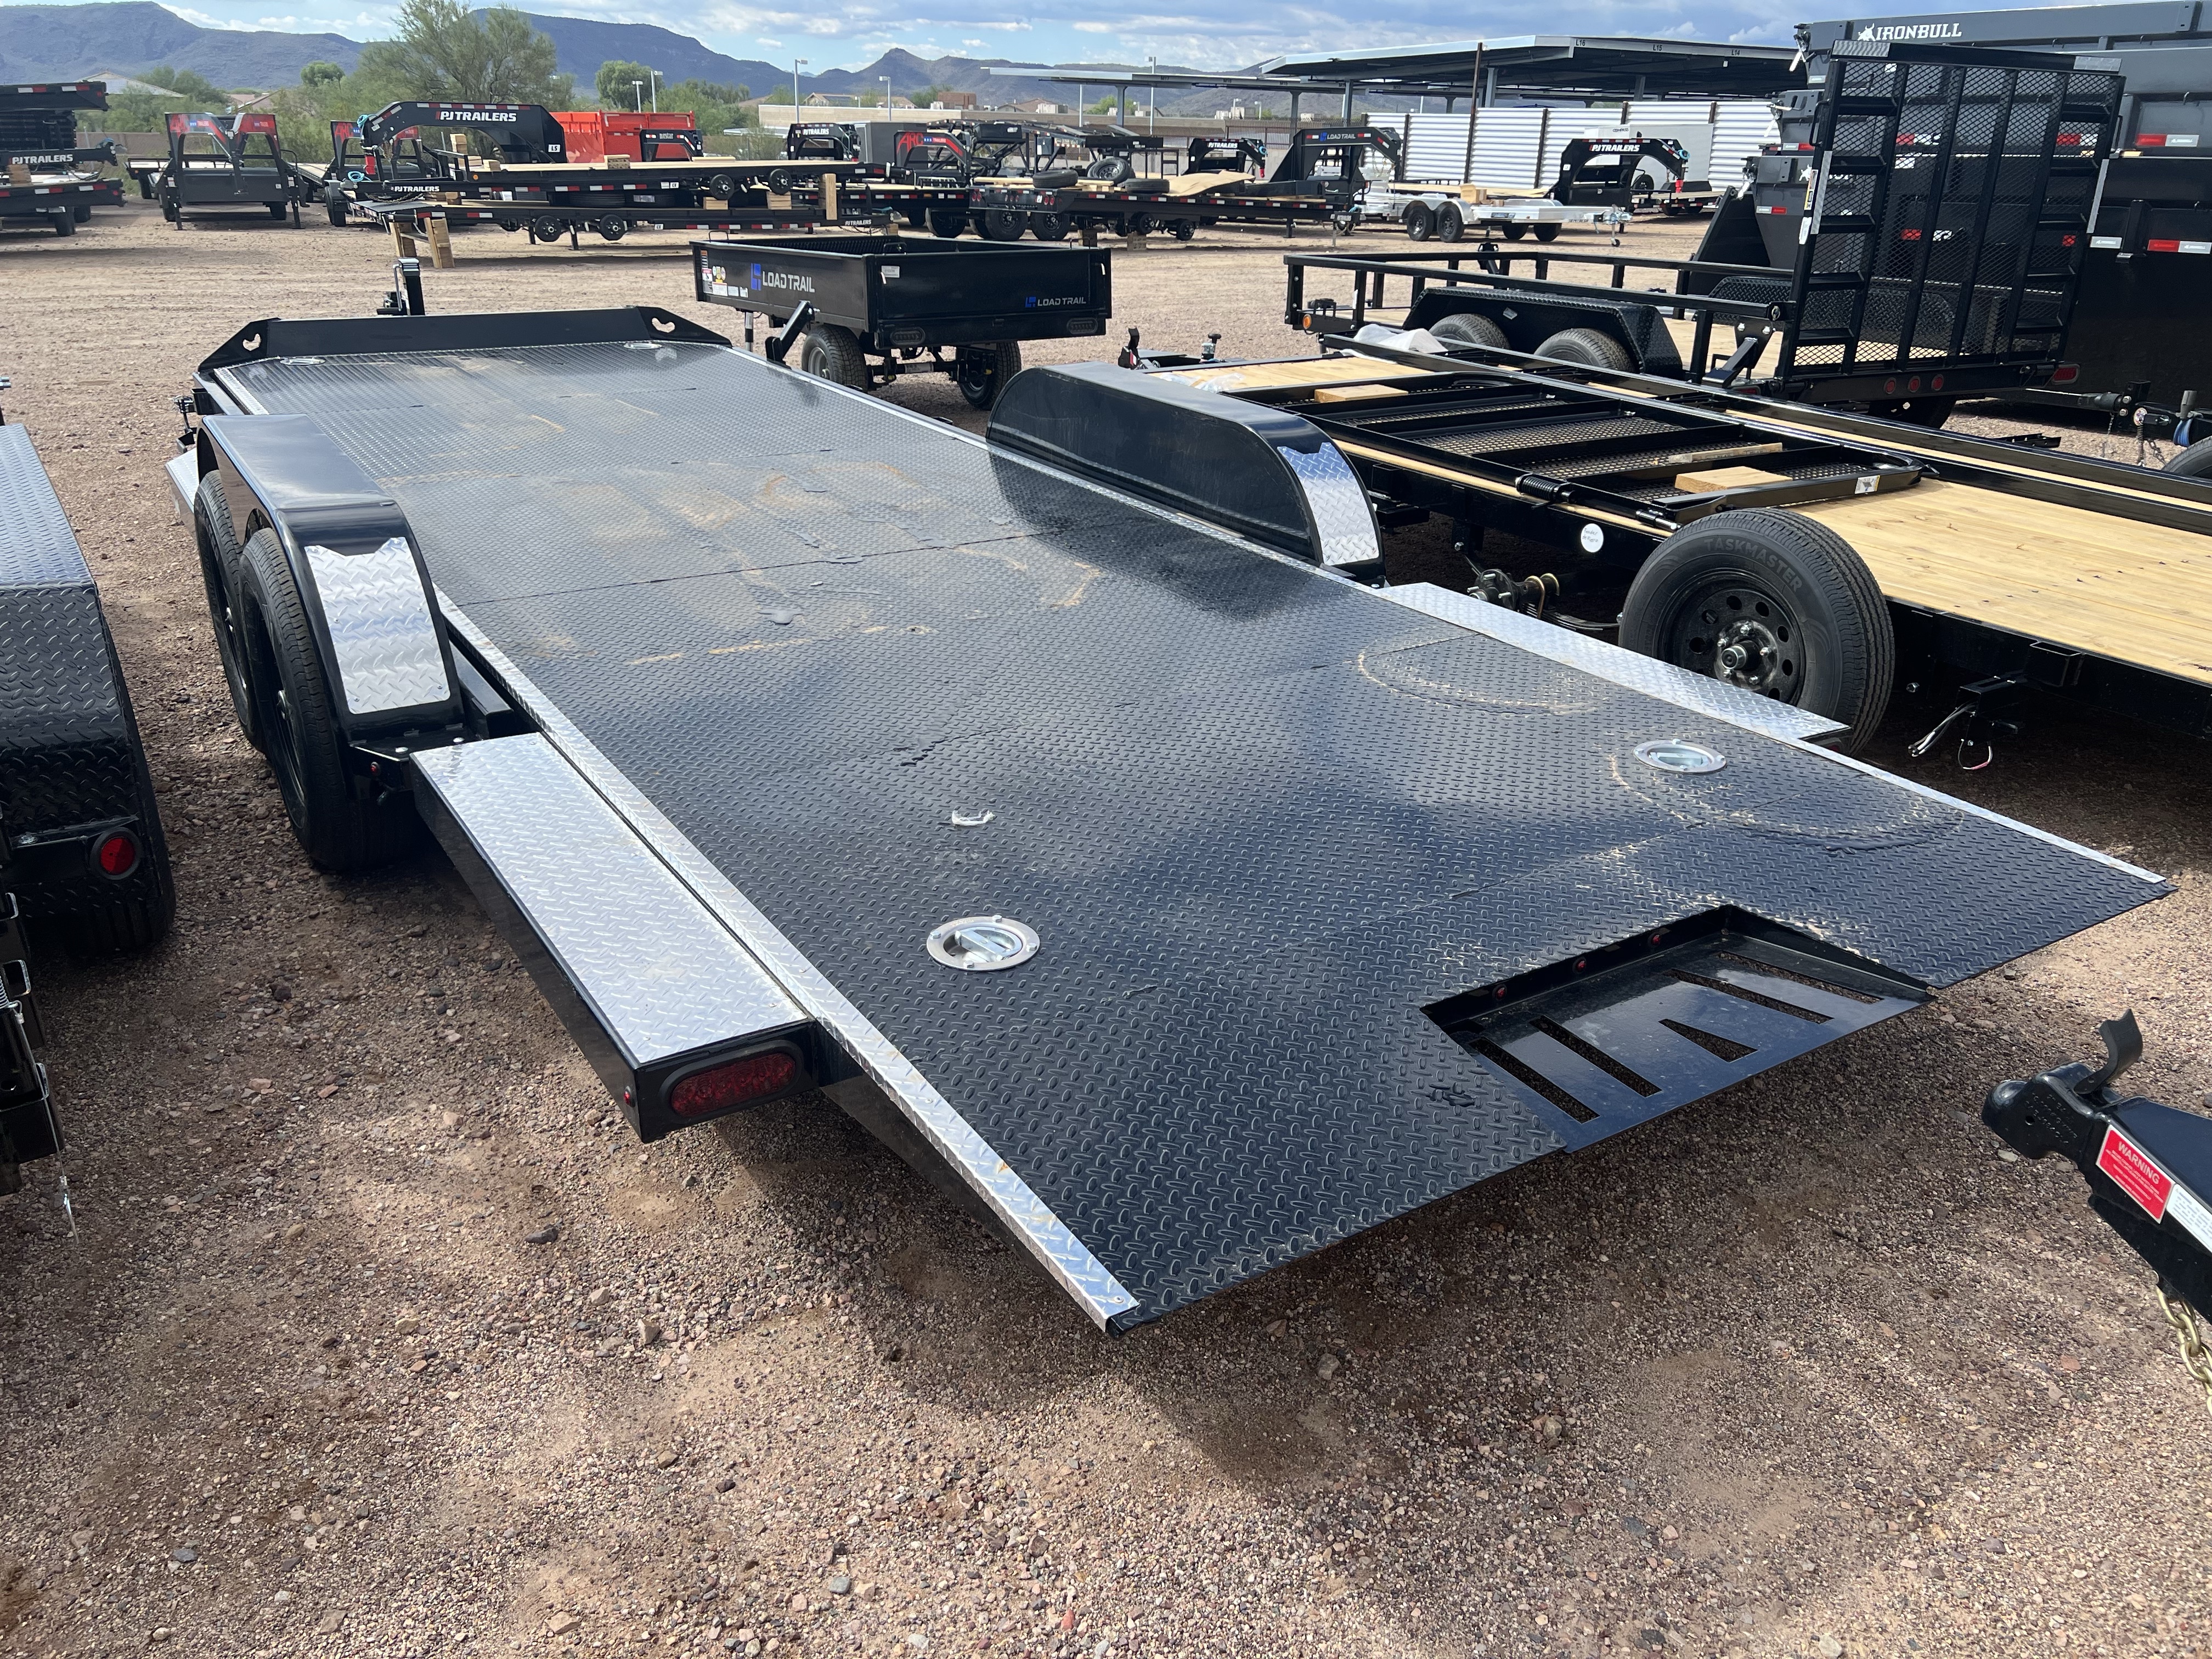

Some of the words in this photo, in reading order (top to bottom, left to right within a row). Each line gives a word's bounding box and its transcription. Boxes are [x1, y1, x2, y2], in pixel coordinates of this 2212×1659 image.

[1876, 22, 1962, 41] IRONBULL
[1704, 537, 1803, 592] TASKMASTER
[2118, 1141, 2160, 1185] WARNING
